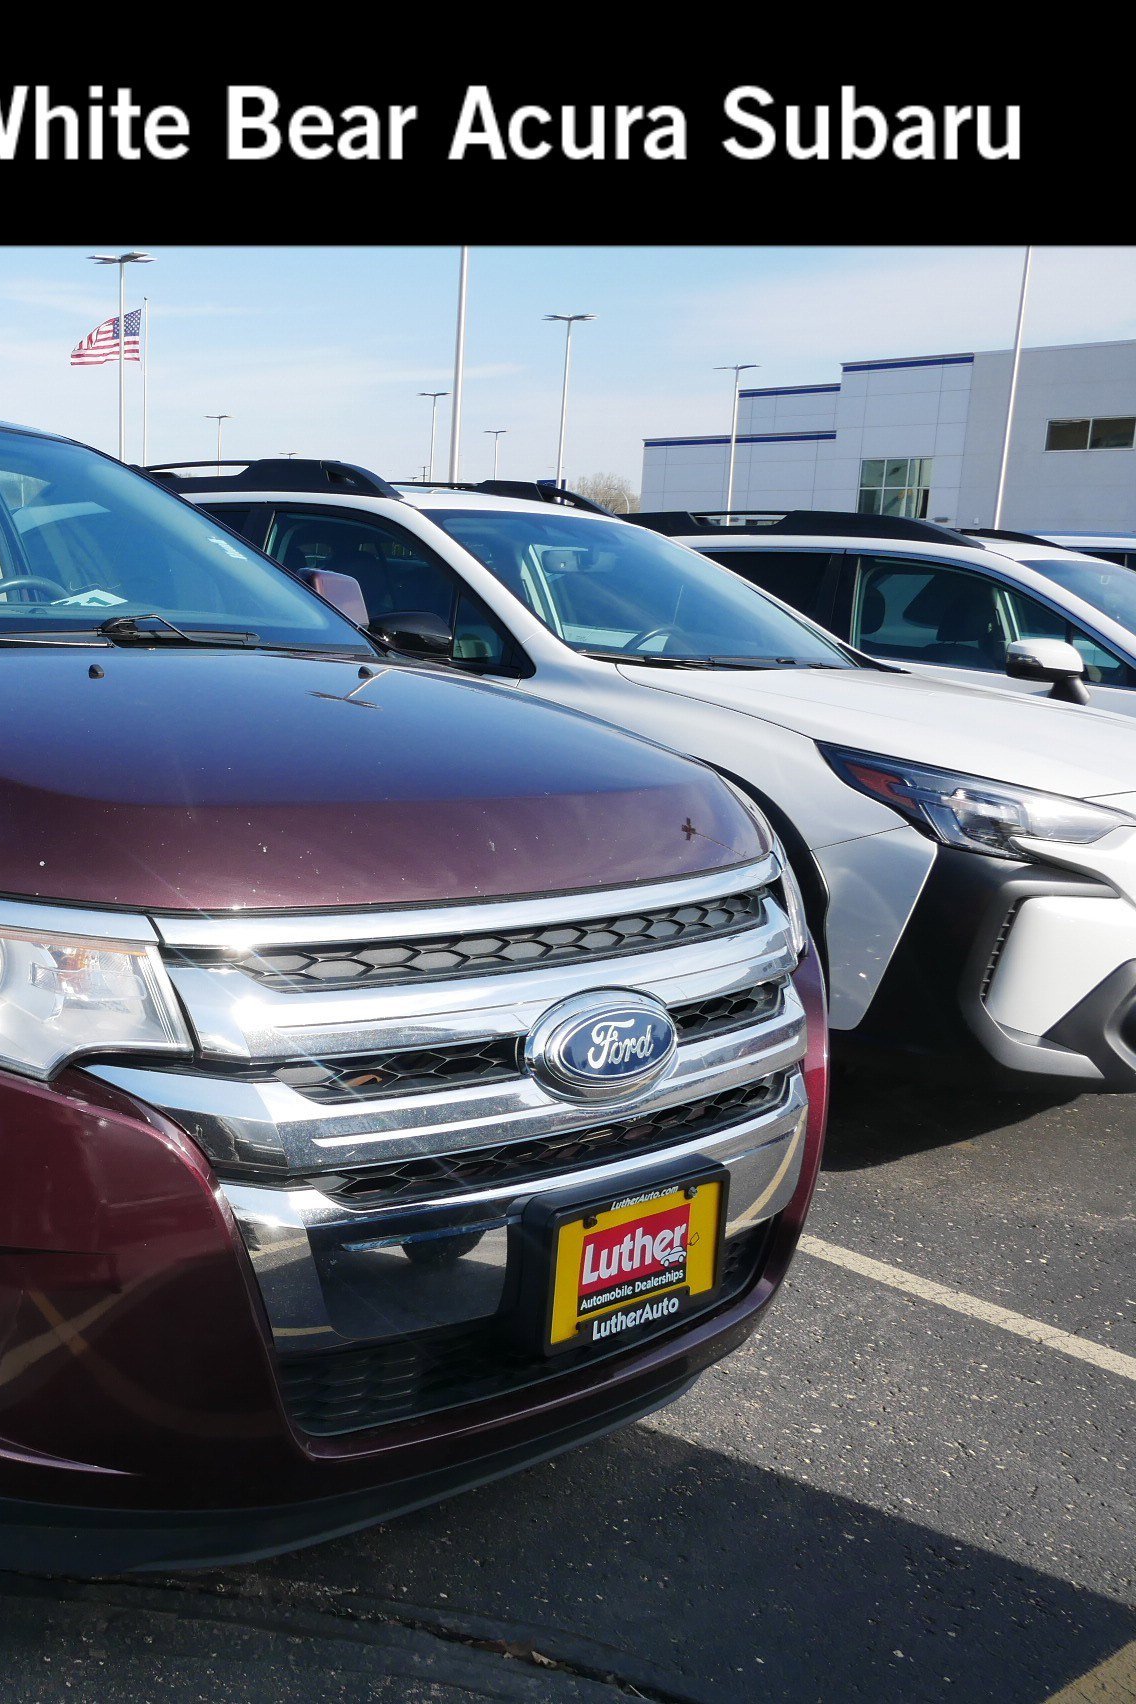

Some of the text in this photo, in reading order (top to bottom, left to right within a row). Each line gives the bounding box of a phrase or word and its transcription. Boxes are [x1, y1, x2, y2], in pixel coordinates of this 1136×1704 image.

[587, 1018, 654, 1069] Ford
[610, 1185, 679, 1211] LutherAuto.com
[582, 1222, 687, 1285] Luther
[580, 1269, 684, 1311] Automobile Dealerships
[592, 1297, 679, 1341] LutherAuto
